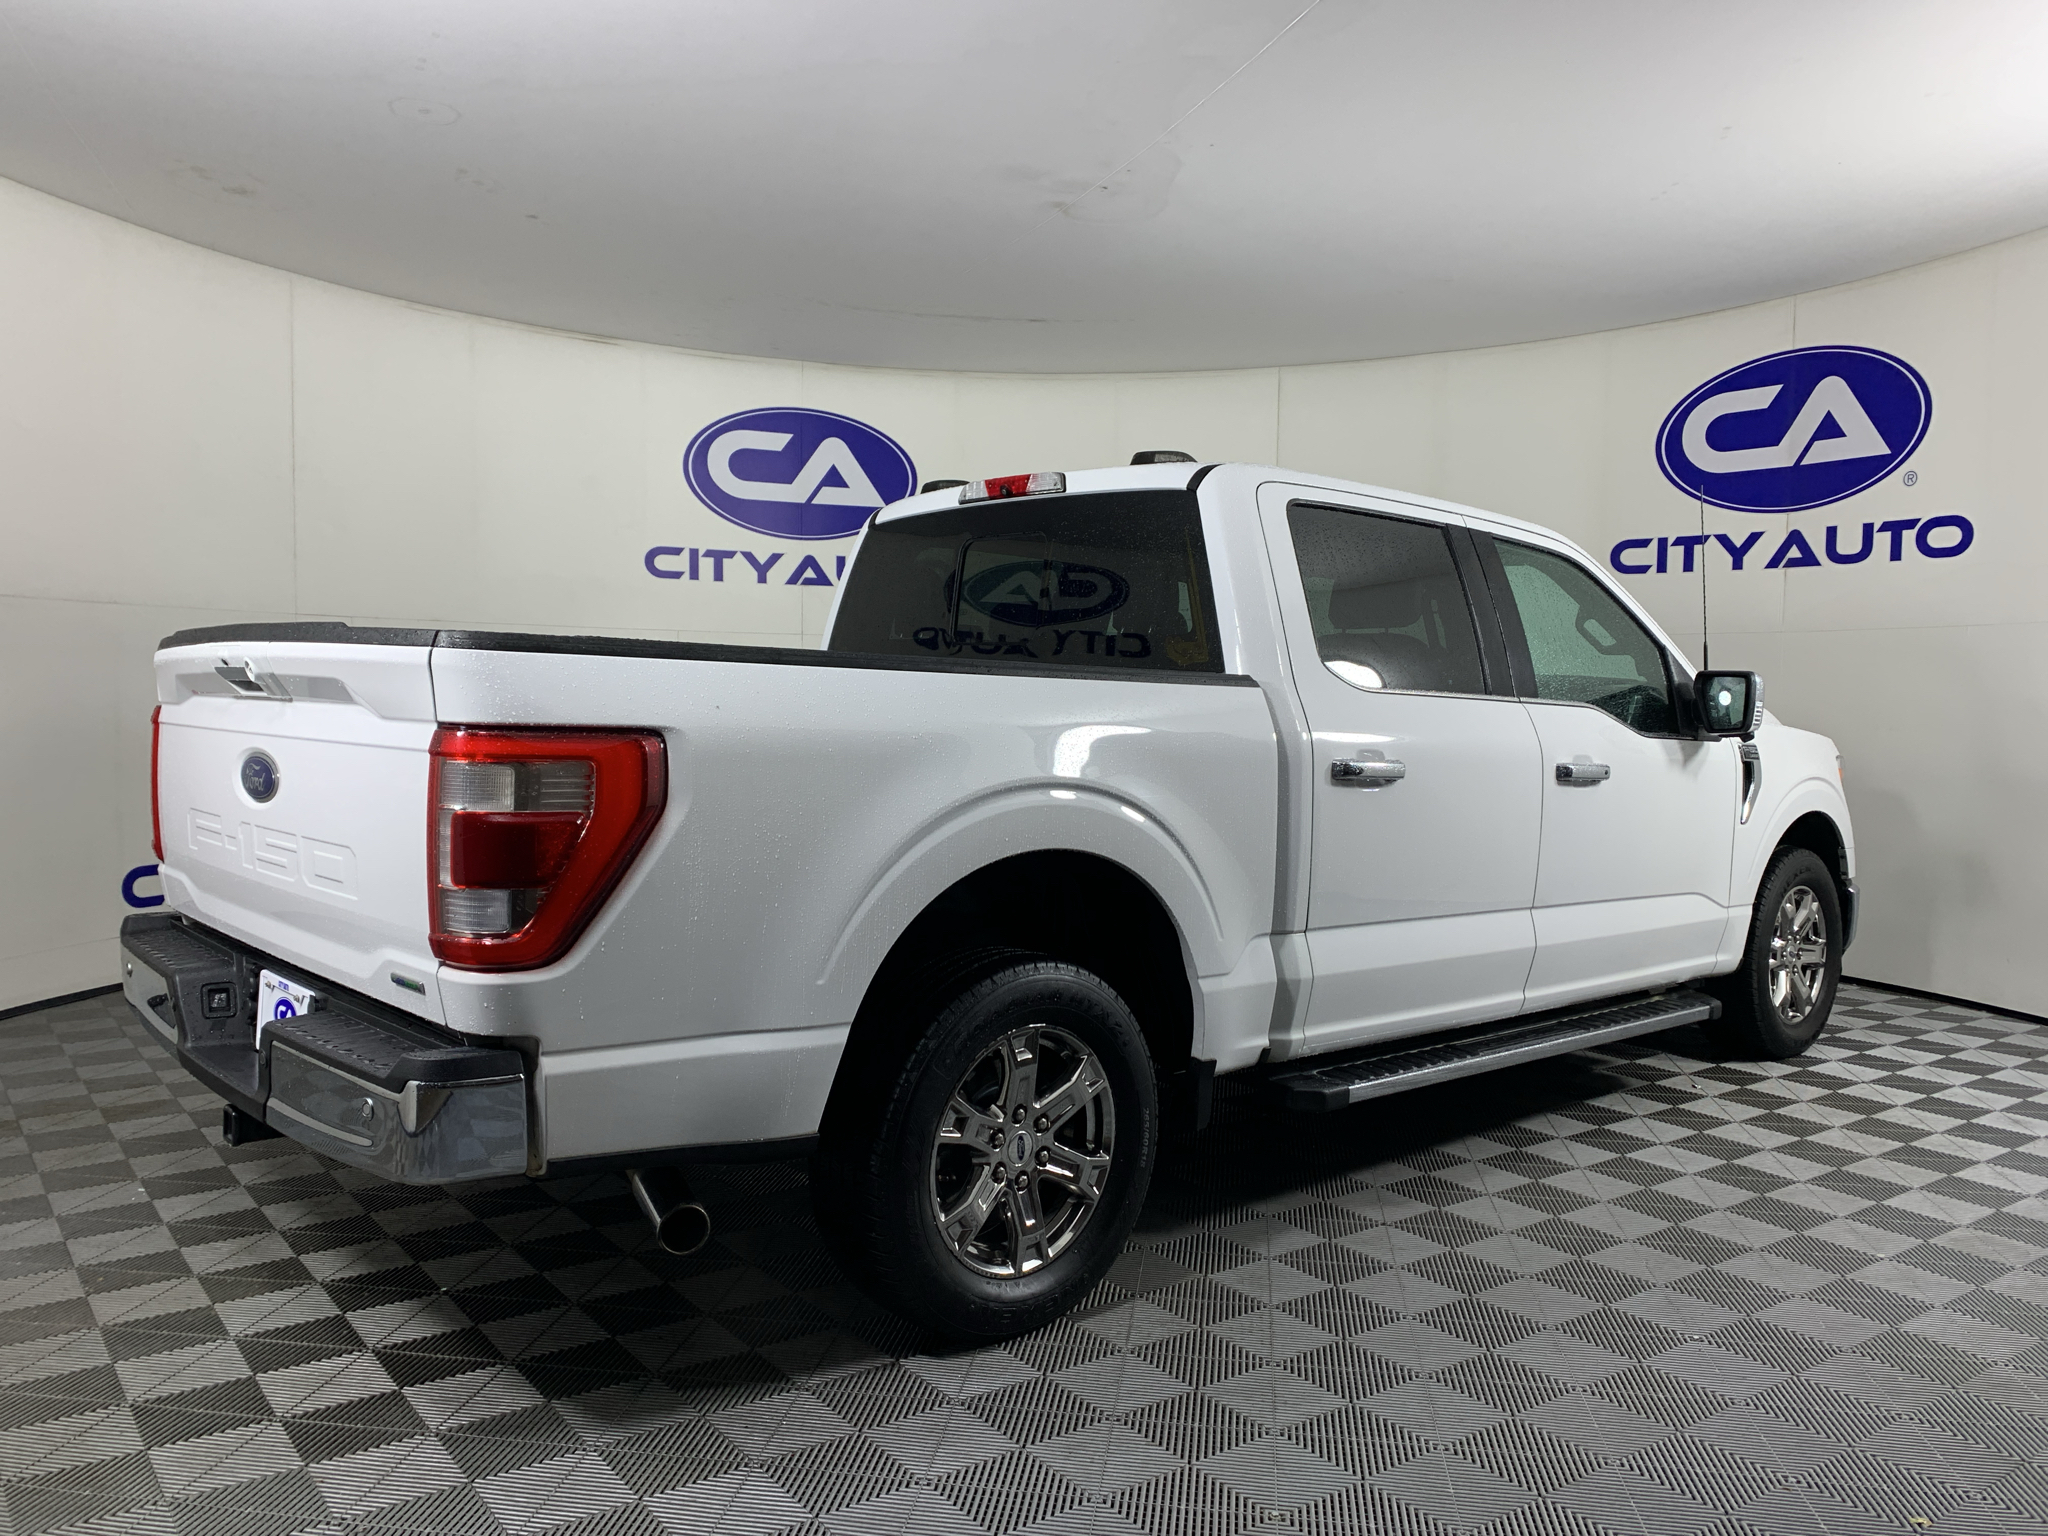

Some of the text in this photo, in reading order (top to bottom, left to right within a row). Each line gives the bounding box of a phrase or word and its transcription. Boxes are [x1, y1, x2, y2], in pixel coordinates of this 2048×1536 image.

[1682, 375, 1892, 474] CA
[707, 429, 886, 507] CA
[644, 546, 785, 584] CITY
[1610, 515, 1974, 574] CITY AUTO
[244, 763, 266, 792] Ford
[186, 807, 358, 900] F-150
